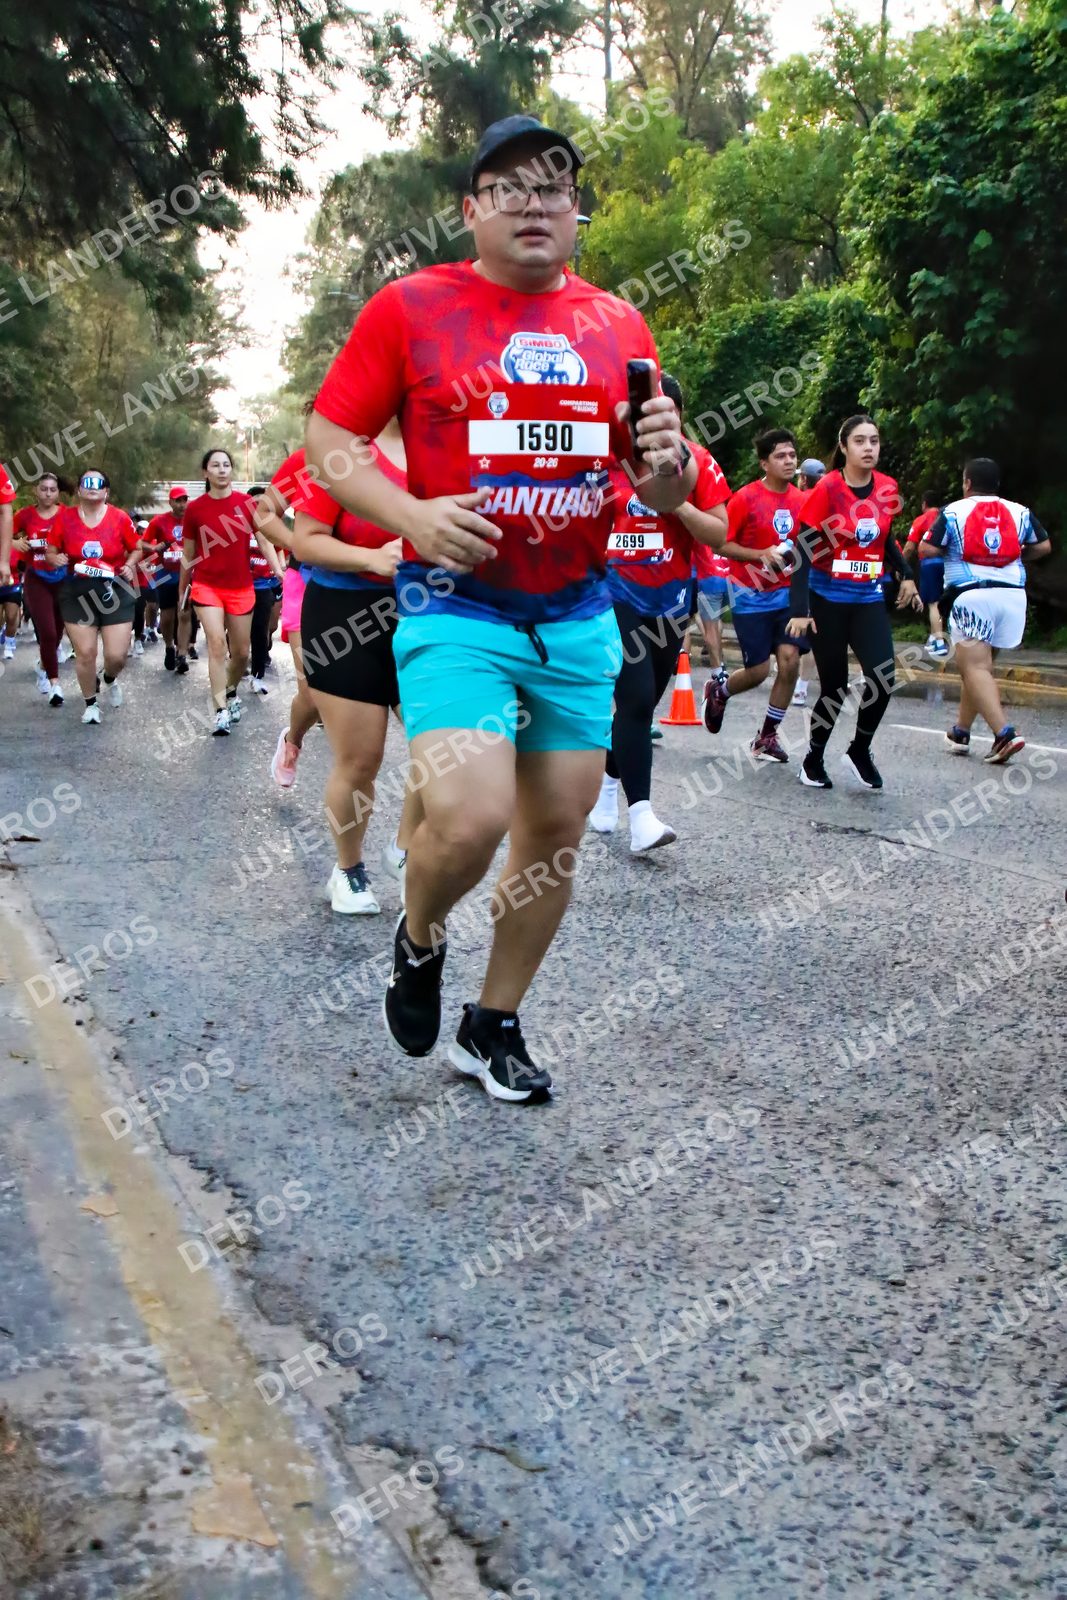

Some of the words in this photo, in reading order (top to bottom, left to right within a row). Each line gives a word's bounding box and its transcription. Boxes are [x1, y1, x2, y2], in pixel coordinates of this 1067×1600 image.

[517, 423, 573, 451] 1590
[616, 535, 645, 548] 2699
[850, 562, 868, 572] 1516
